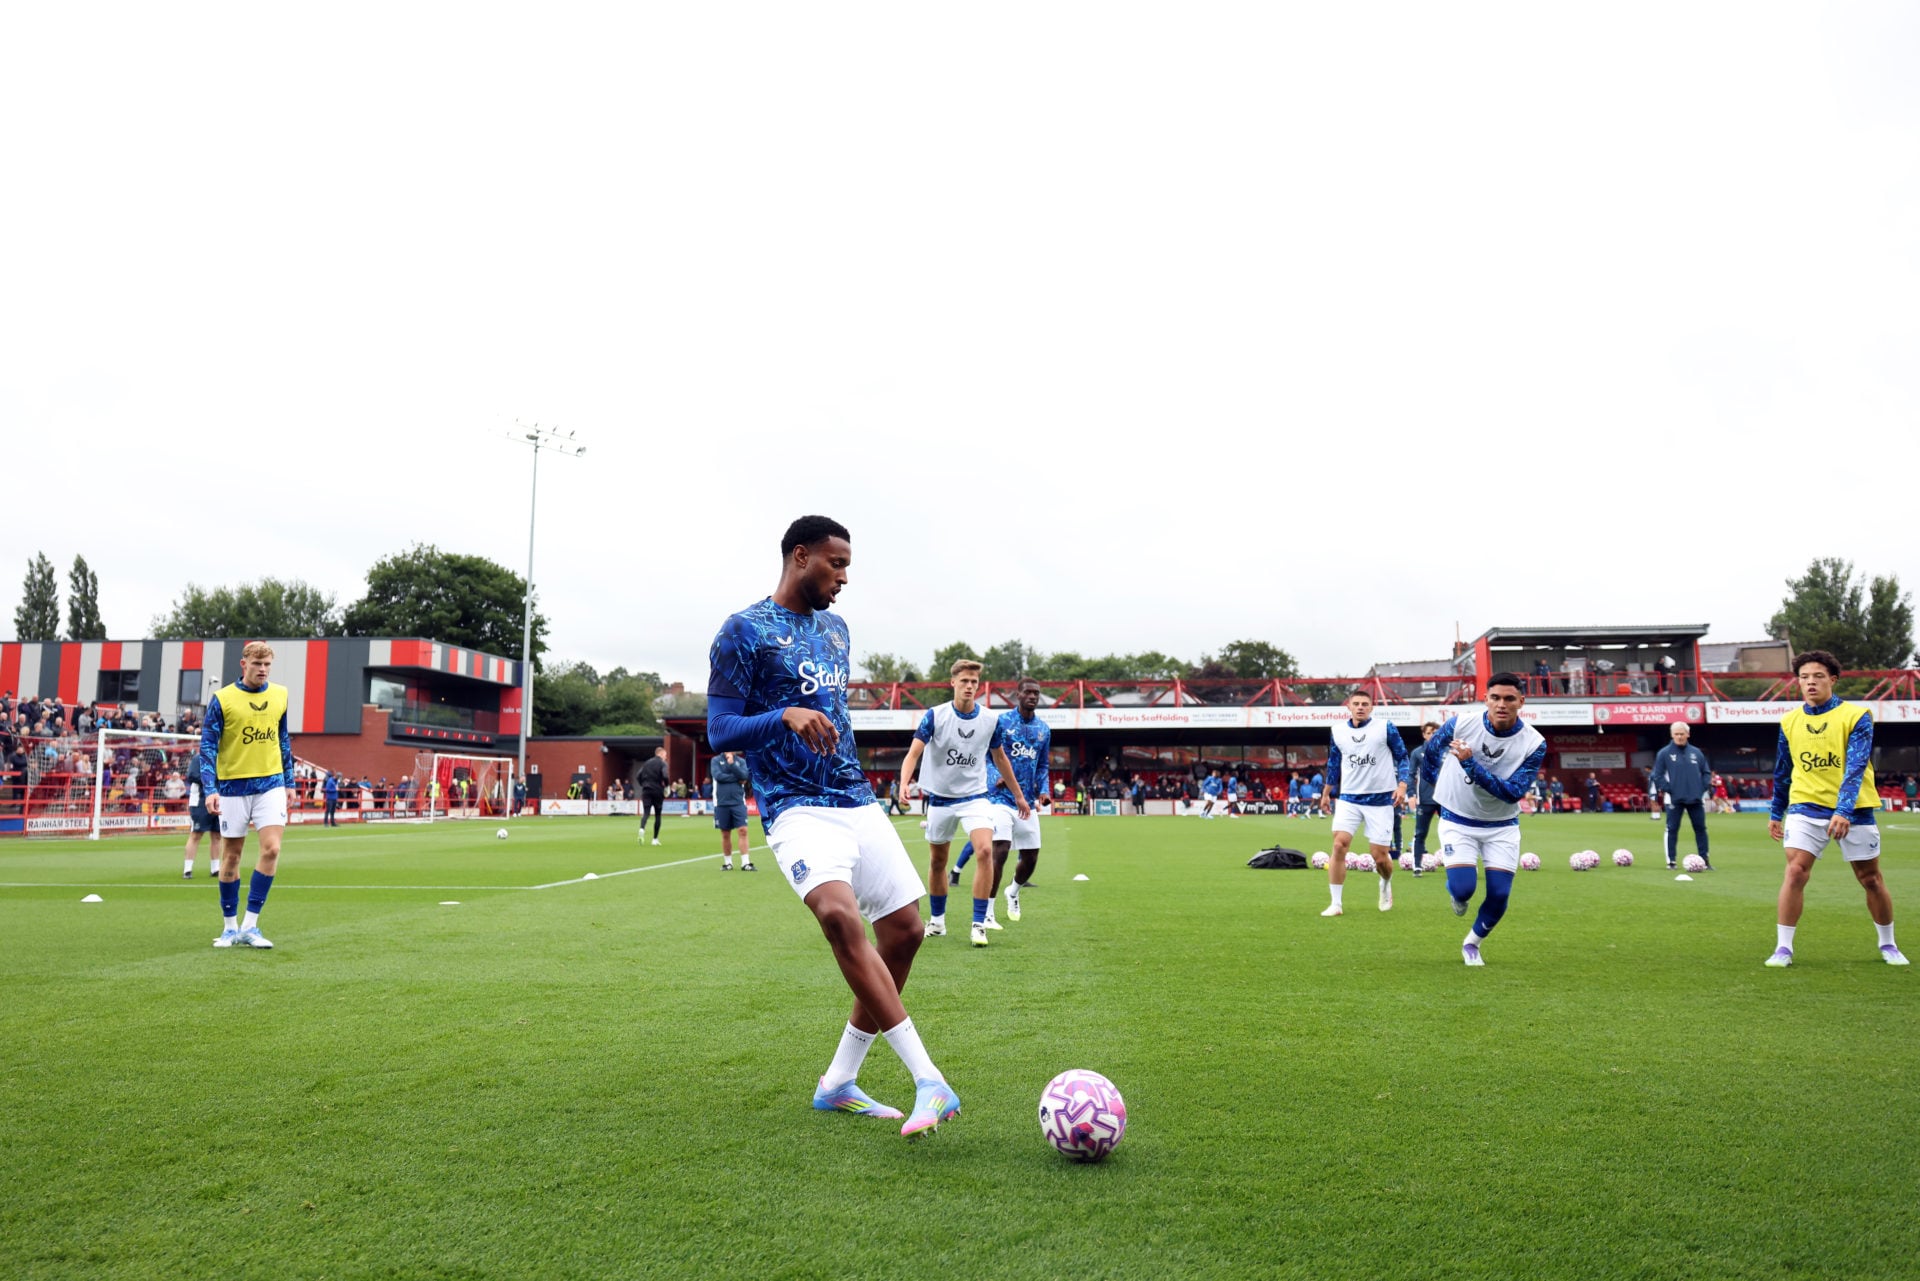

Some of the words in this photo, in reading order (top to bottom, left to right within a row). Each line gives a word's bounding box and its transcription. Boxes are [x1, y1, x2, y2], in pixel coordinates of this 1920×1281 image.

[798, 661, 847, 695] Stake
[1613, 705, 1639, 714] JACK
[1640, 704, 1685, 713] BARRETT
[1725, 707, 1759, 716] Taylors
[1108, 714, 1139, 723] Taylors
[1141, 713, 1189, 723] Scaffolding
[1277, 713, 1309, 721] Taylors
[1632, 714, 1666, 722] STAND
[242, 725, 276, 744] Stake
[1010, 741, 1037, 760] Stake
[946, 748, 977, 767] Stake
[1348, 753, 1377, 769] Stake
[1799, 751, 1842, 773] Stake
[28, 820, 63, 829] RAINHAM
[64, 819, 88, 828] STEEL
[126, 817, 146, 826] STEEL
